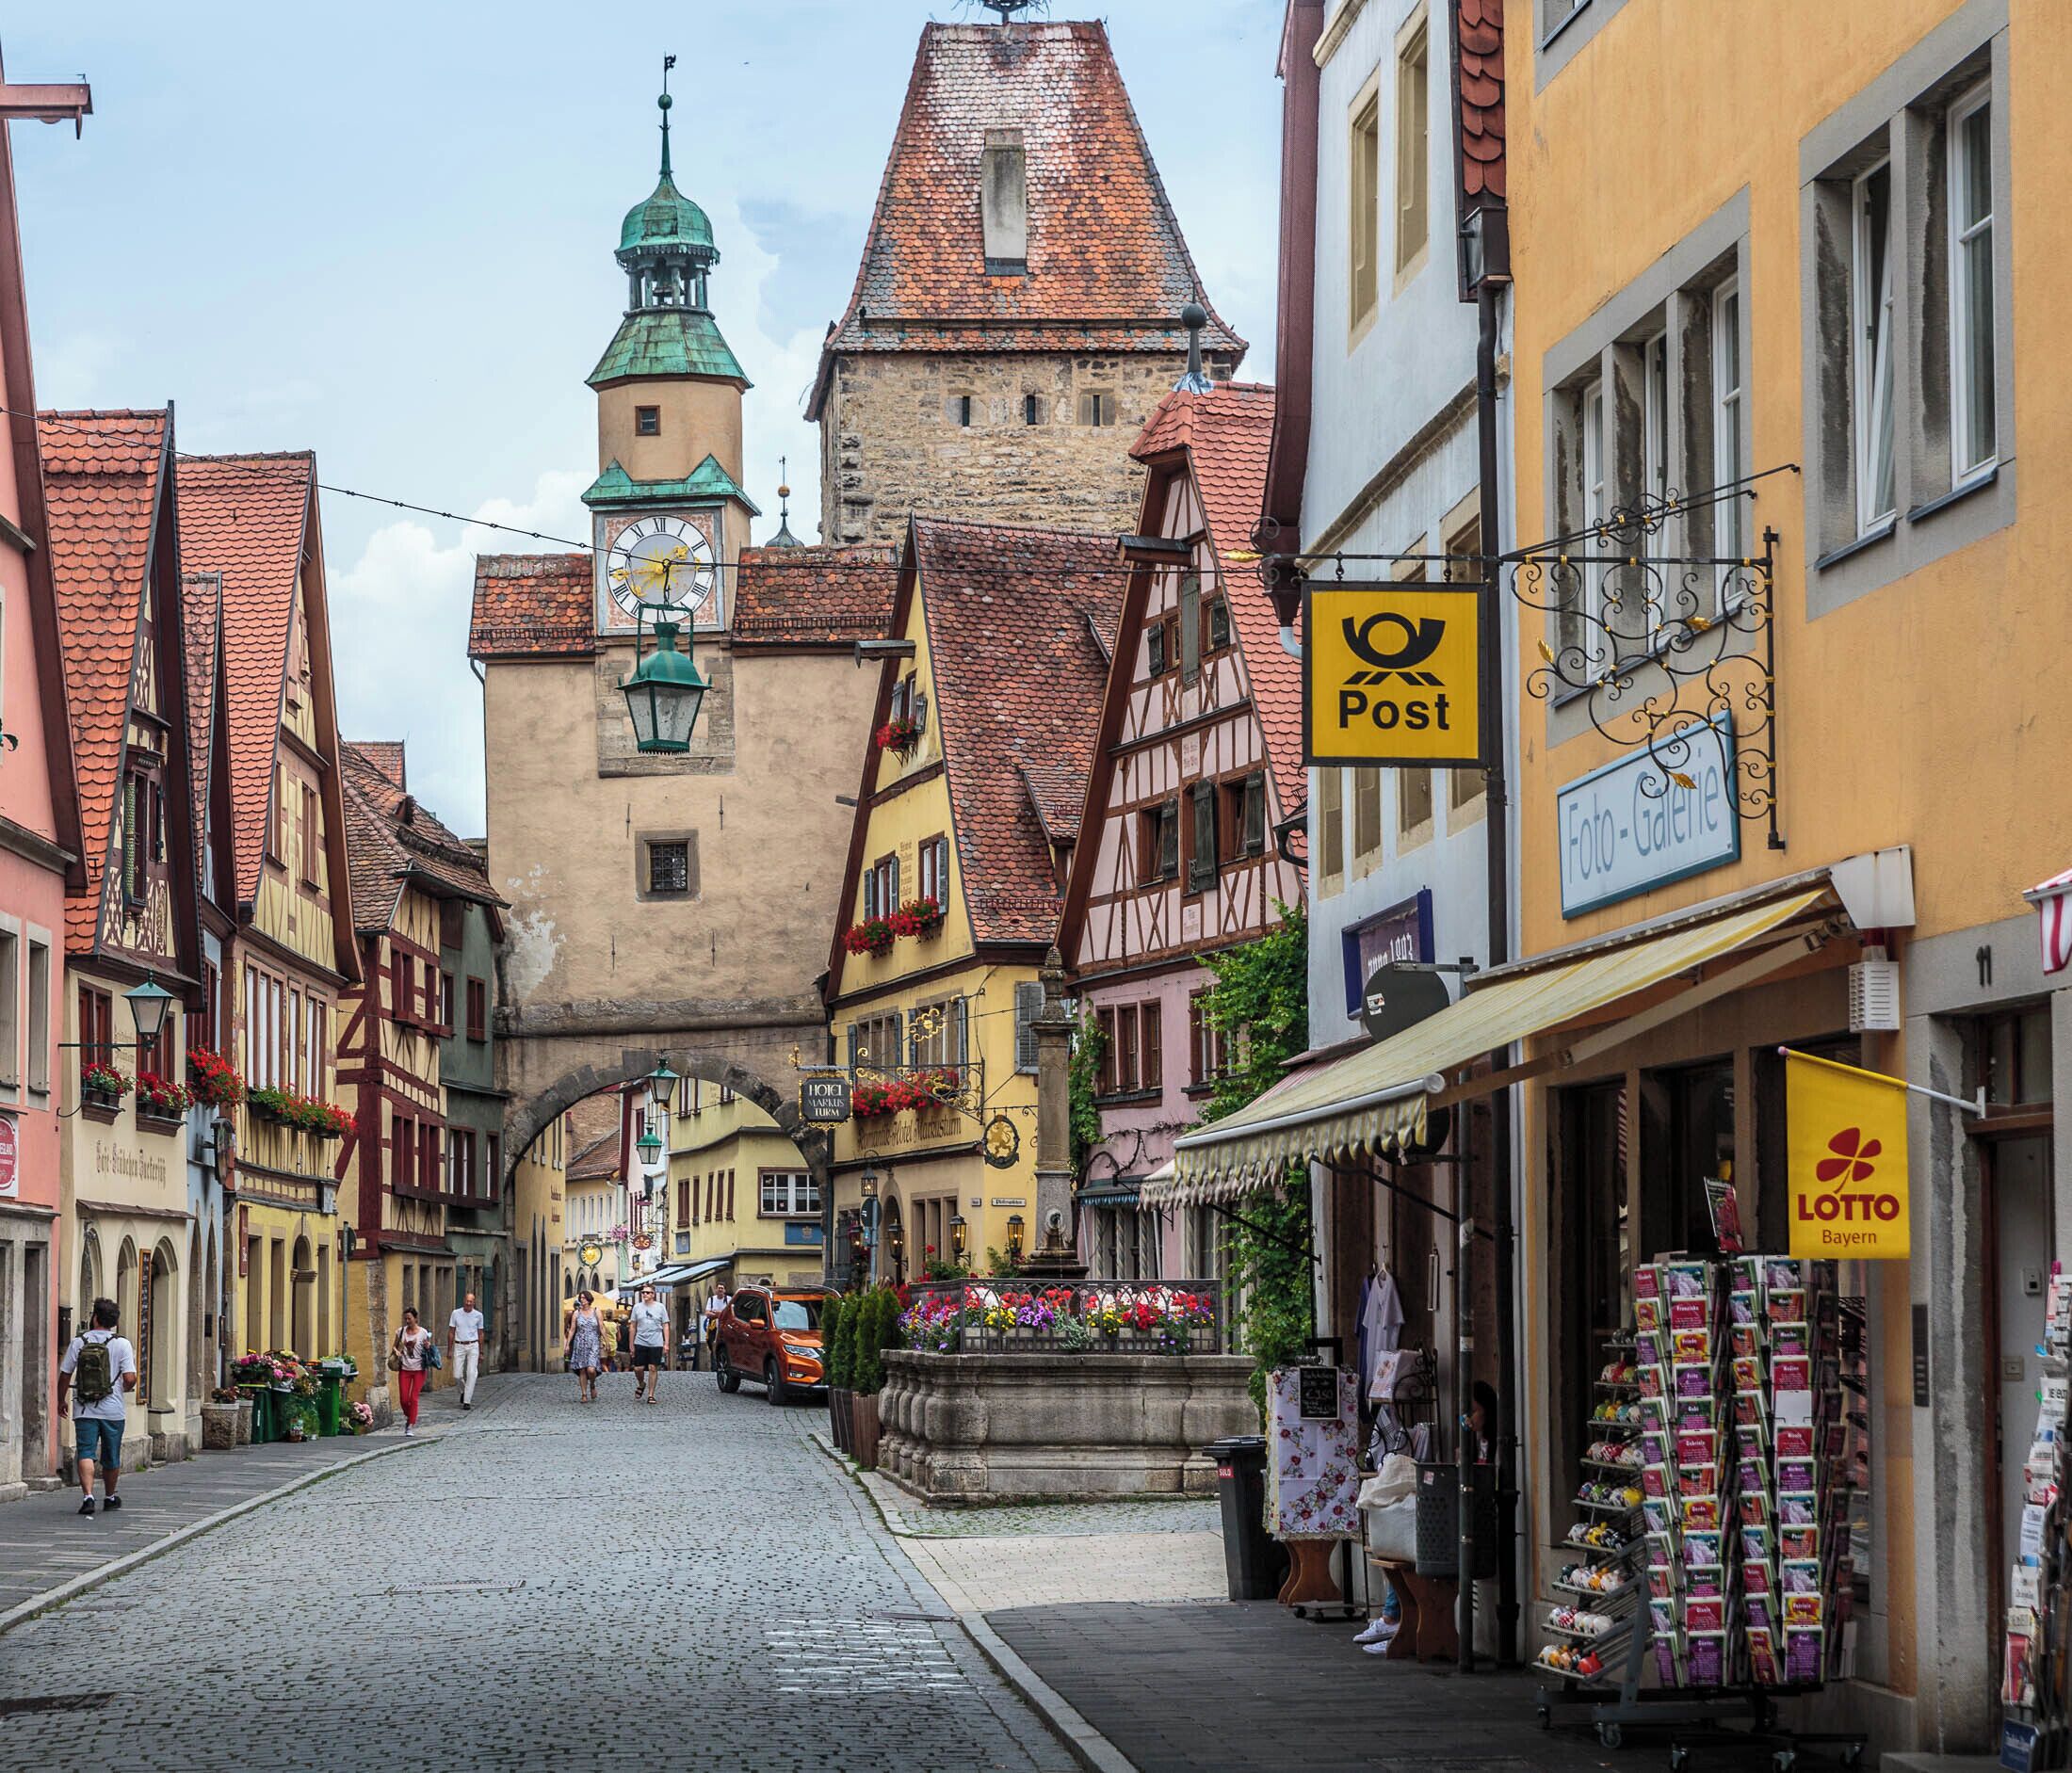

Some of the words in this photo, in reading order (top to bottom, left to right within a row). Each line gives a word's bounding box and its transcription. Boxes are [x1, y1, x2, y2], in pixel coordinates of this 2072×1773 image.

[653, 517, 667, 533] XII
[1338, 689, 1450, 731] Post
[1976, 944, 1992, 987] 11
[808, 1084, 843, 1097] HOTEL
[808, 1098, 845, 1107] MARKUS
[814, 1107, 840, 1117] TURM
[1798, 1193, 1901, 1221] LOTTO
[1822, 1229, 1877, 1248] Bayern
